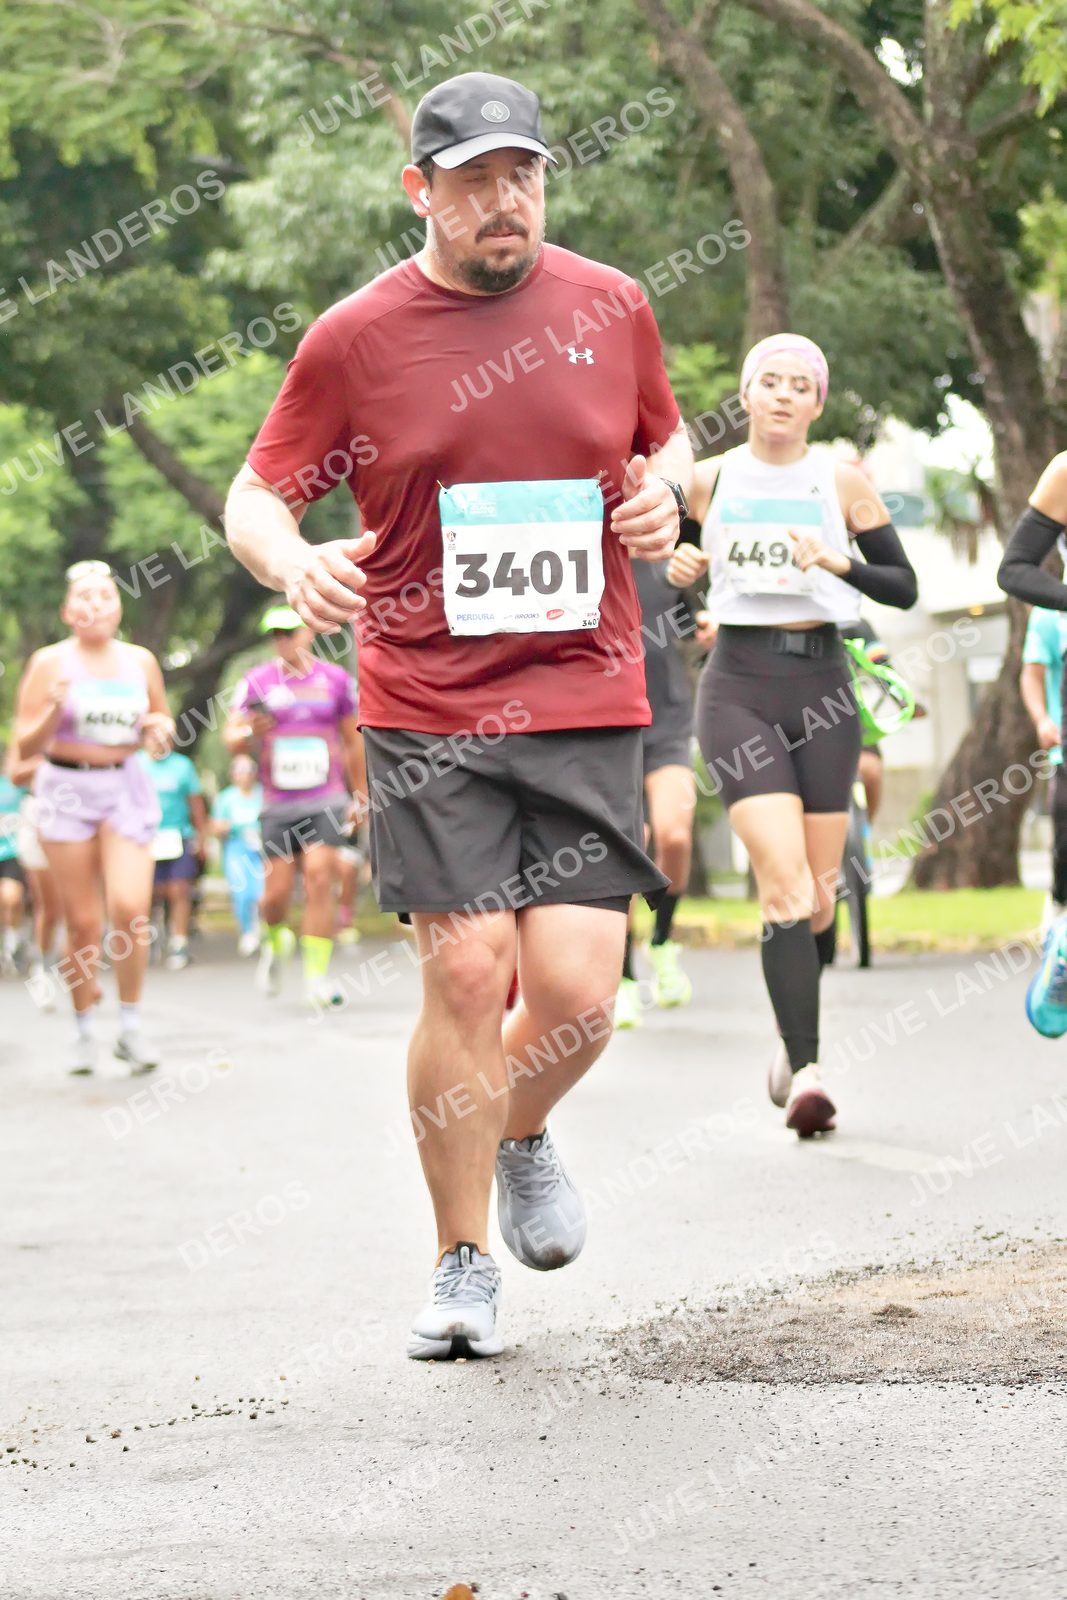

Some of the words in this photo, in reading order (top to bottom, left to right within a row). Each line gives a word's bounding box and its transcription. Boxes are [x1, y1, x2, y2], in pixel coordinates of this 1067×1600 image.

[728, 541, 798, 568] 449
[455, 550, 589, 598] 3401
[456, 613, 495, 622] PERDURA
